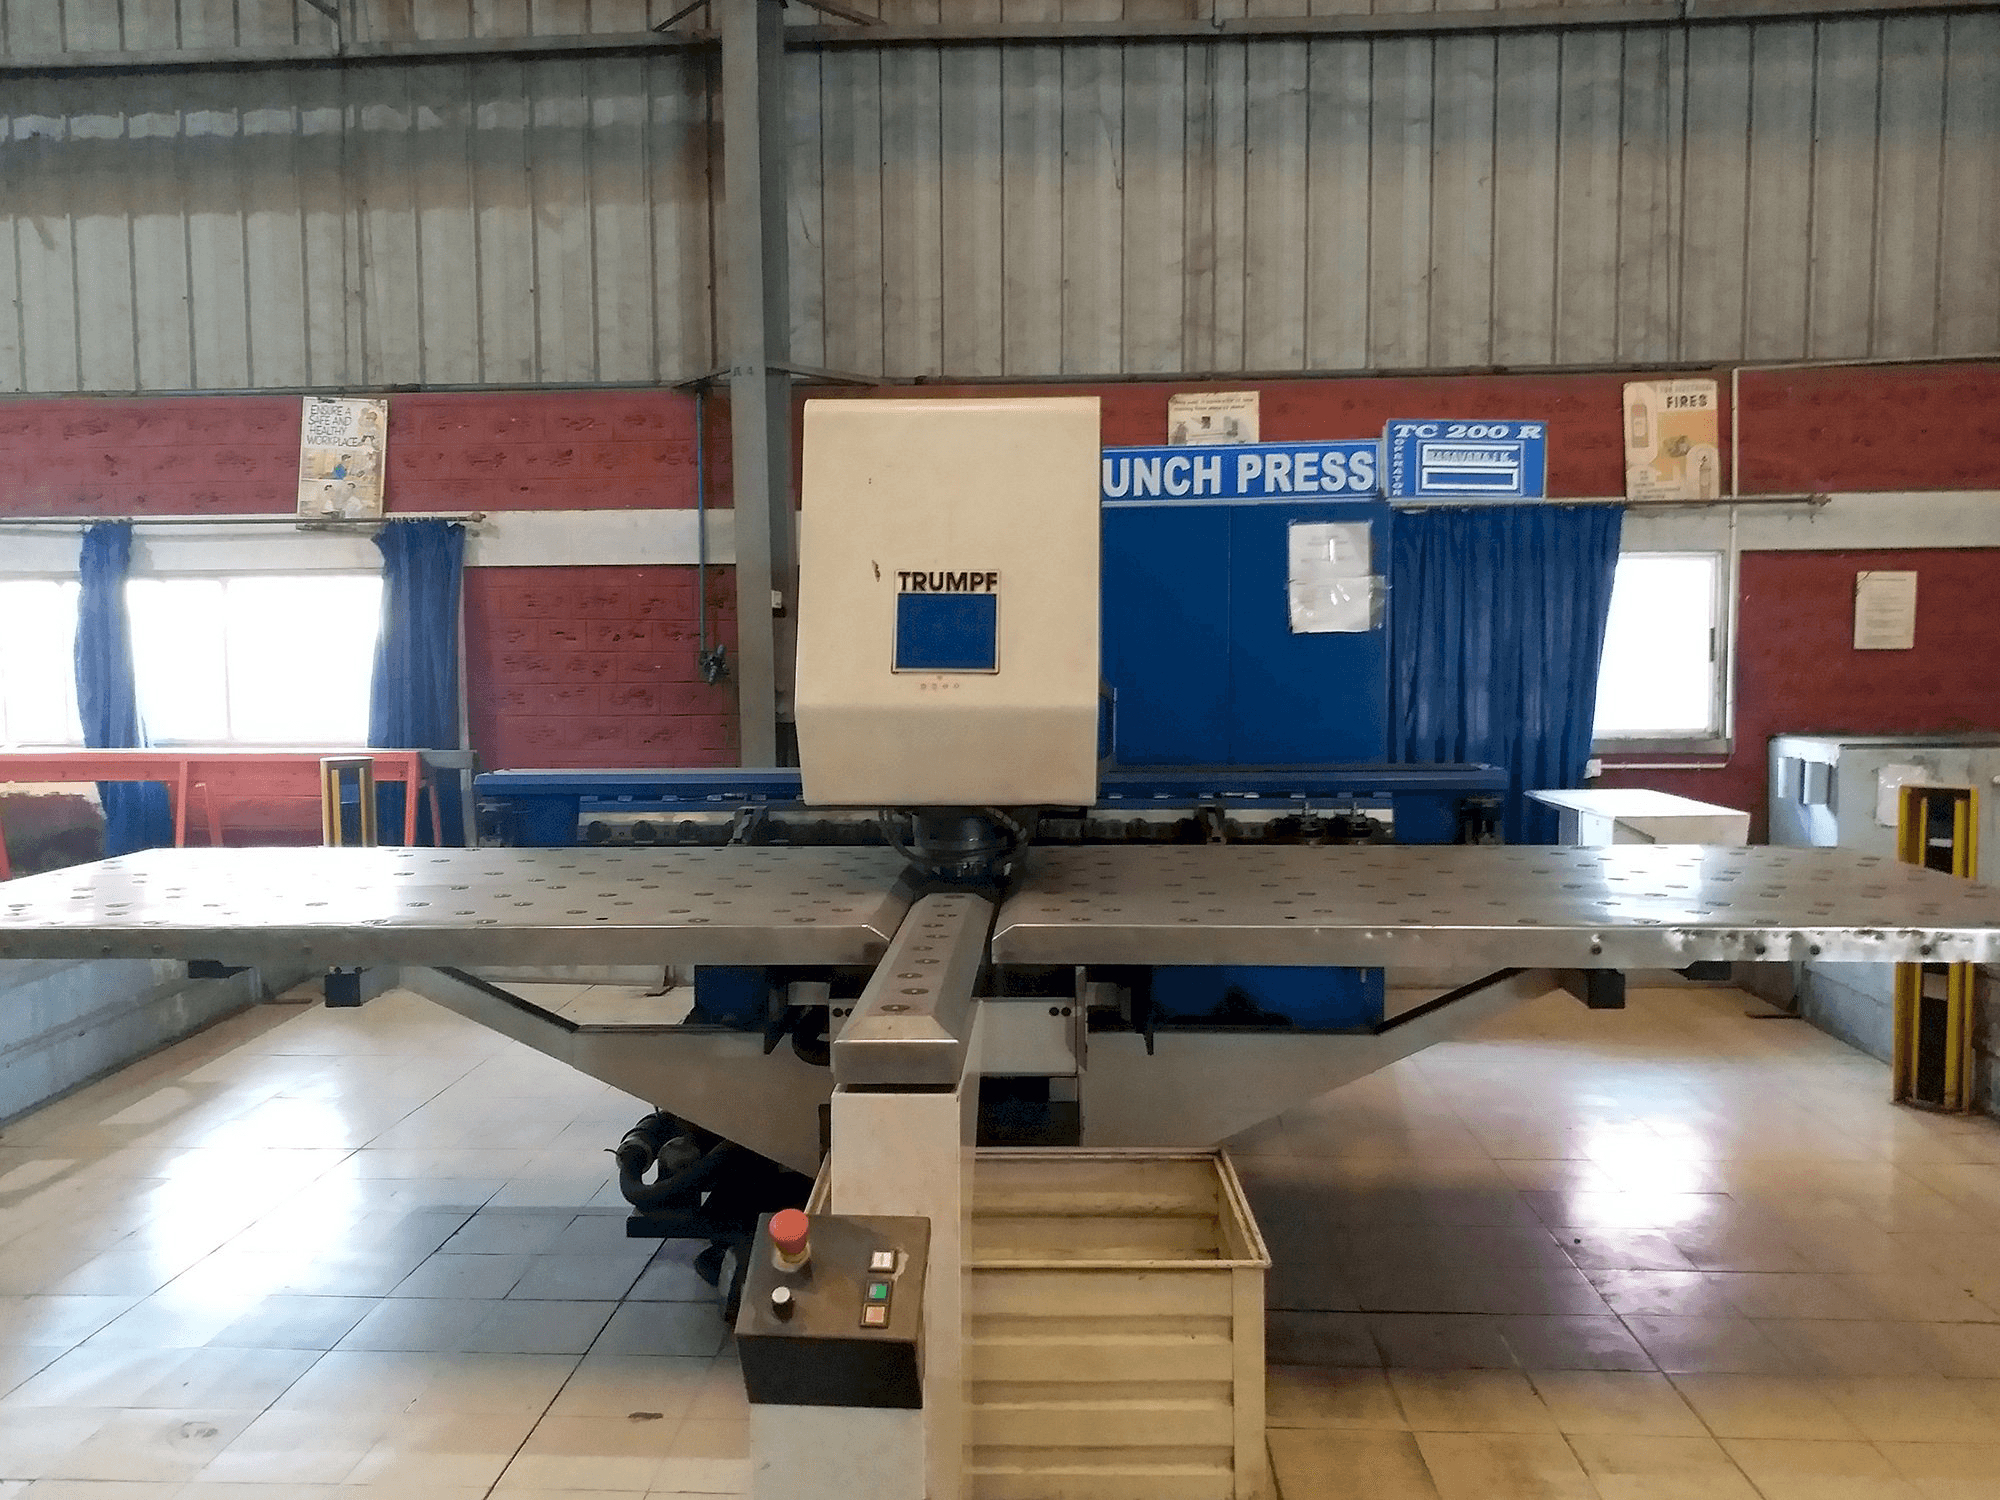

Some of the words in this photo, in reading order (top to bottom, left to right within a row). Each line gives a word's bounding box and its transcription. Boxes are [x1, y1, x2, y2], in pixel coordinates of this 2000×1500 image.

[1666, 394, 1708, 409] FIRES
[310, 404, 343, 416] ENSURE
[345, 407, 352, 416] A
[308, 415, 330, 426] SAFE
[332, 416, 352, 427] AND
[309, 425, 348, 436] HEALTHY
[1393, 424, 1438, 438] TC
[1445, 424, 1510, 439] 200
[1516, 425, 1542, 439] R
[307, 435, 358, 447] WORKPLACE
[1237, 451, 1375, 493] PRESS
[898, 571, 998, 592] TRUMPF
